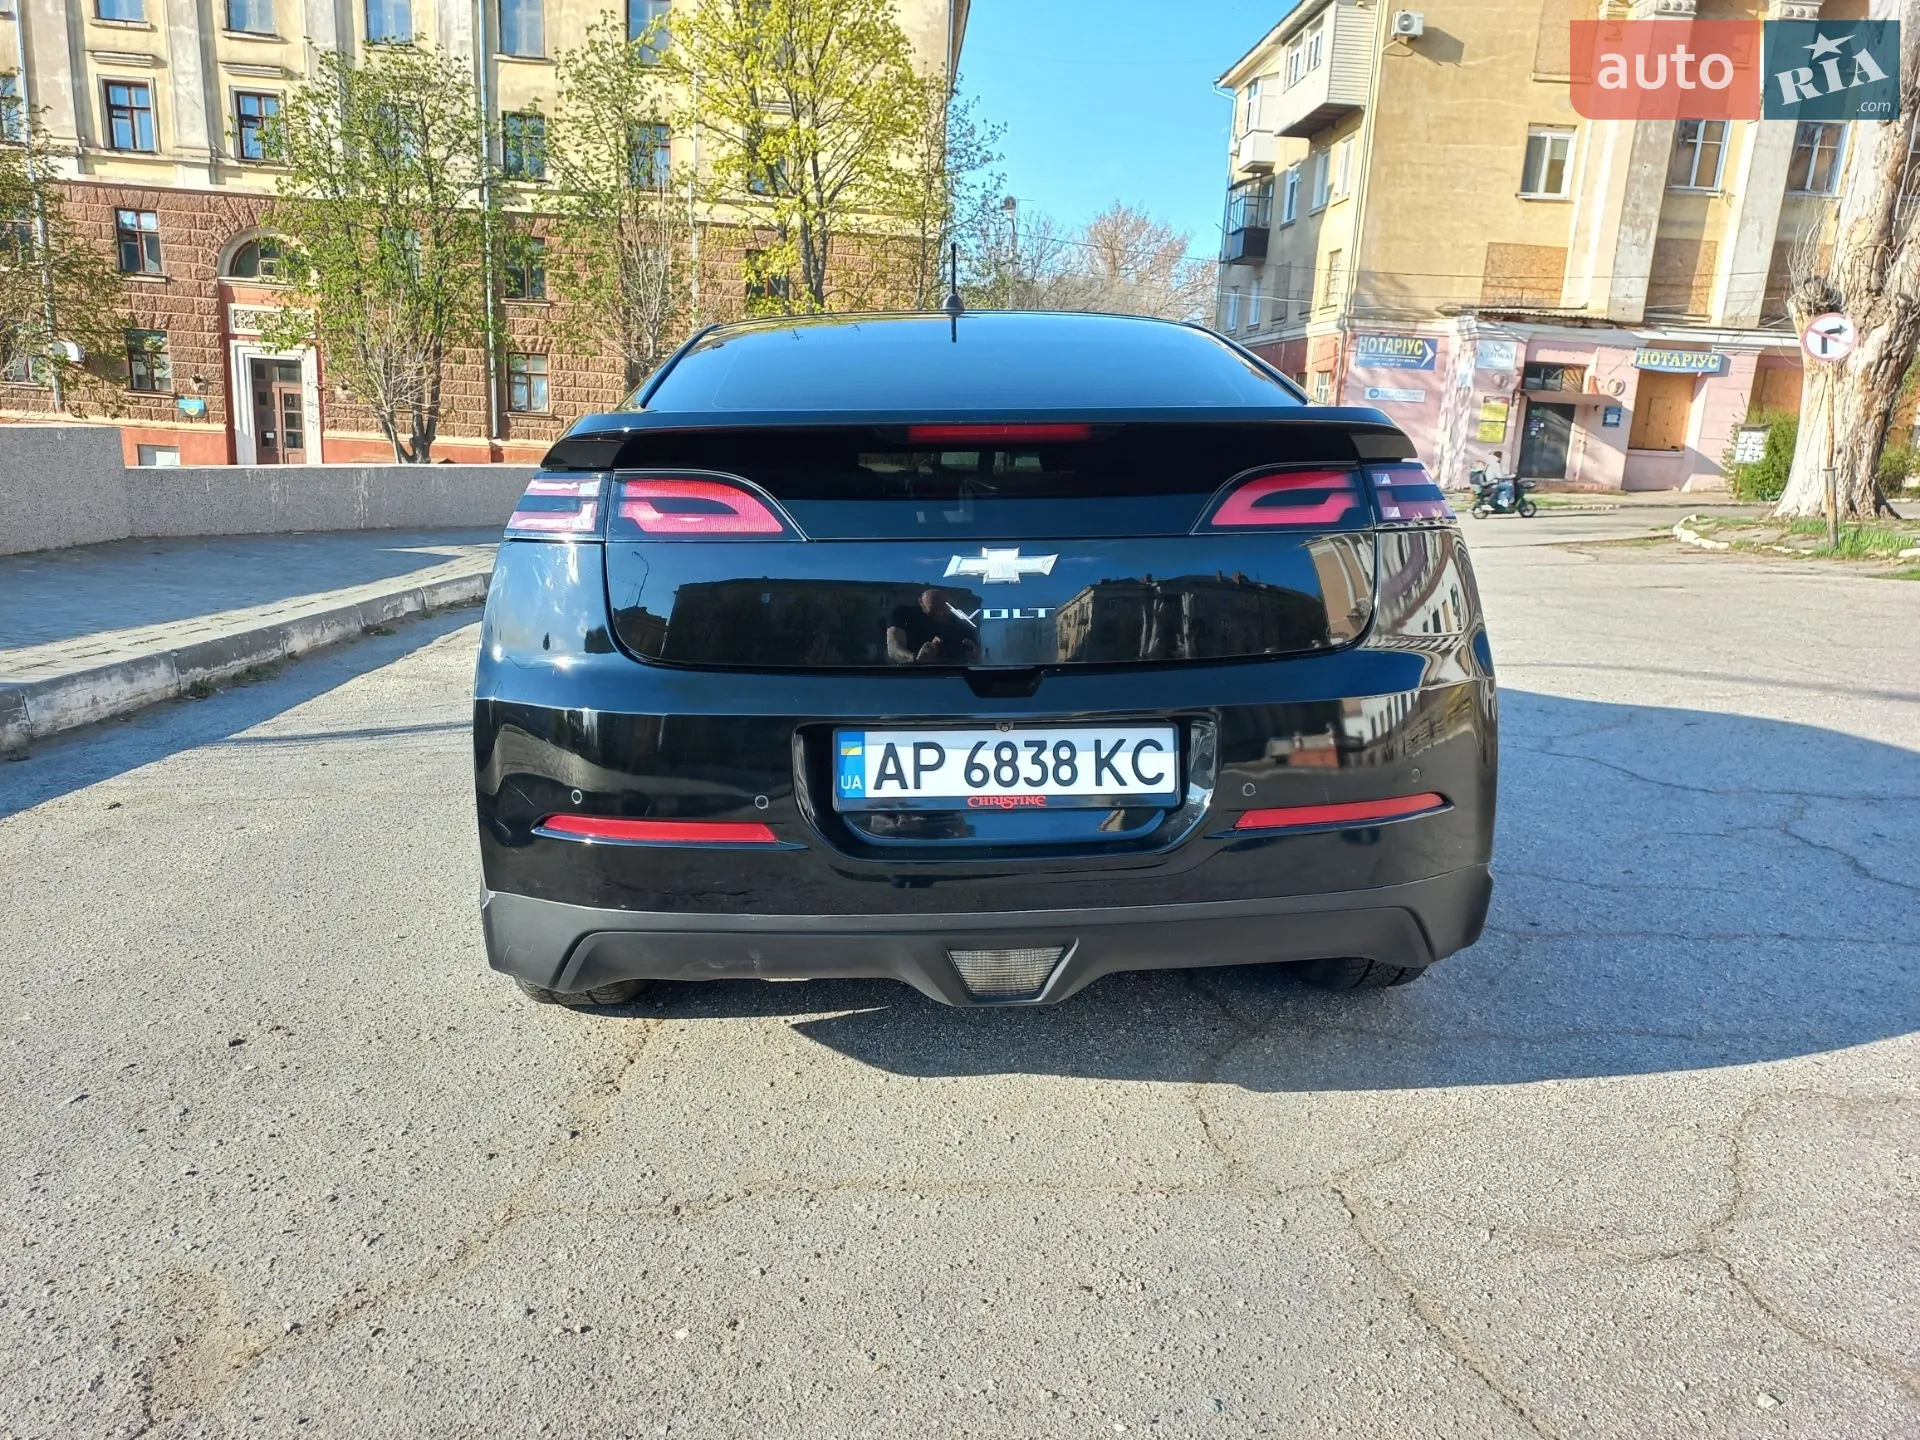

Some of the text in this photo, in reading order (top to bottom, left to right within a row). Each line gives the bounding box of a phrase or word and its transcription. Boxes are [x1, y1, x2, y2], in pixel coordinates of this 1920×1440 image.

[1358, 336, 1424, 356] НОТАРІУС
[1638, 352, 1718, 369] НОТАРІУС
[945, 601, 1056, 628] VOLT
[873, 738, 1165, 790] AP 6838 KC
[840, 775, 863, 790] UA
[967, 794, 1047, 810] CHRISTINE
